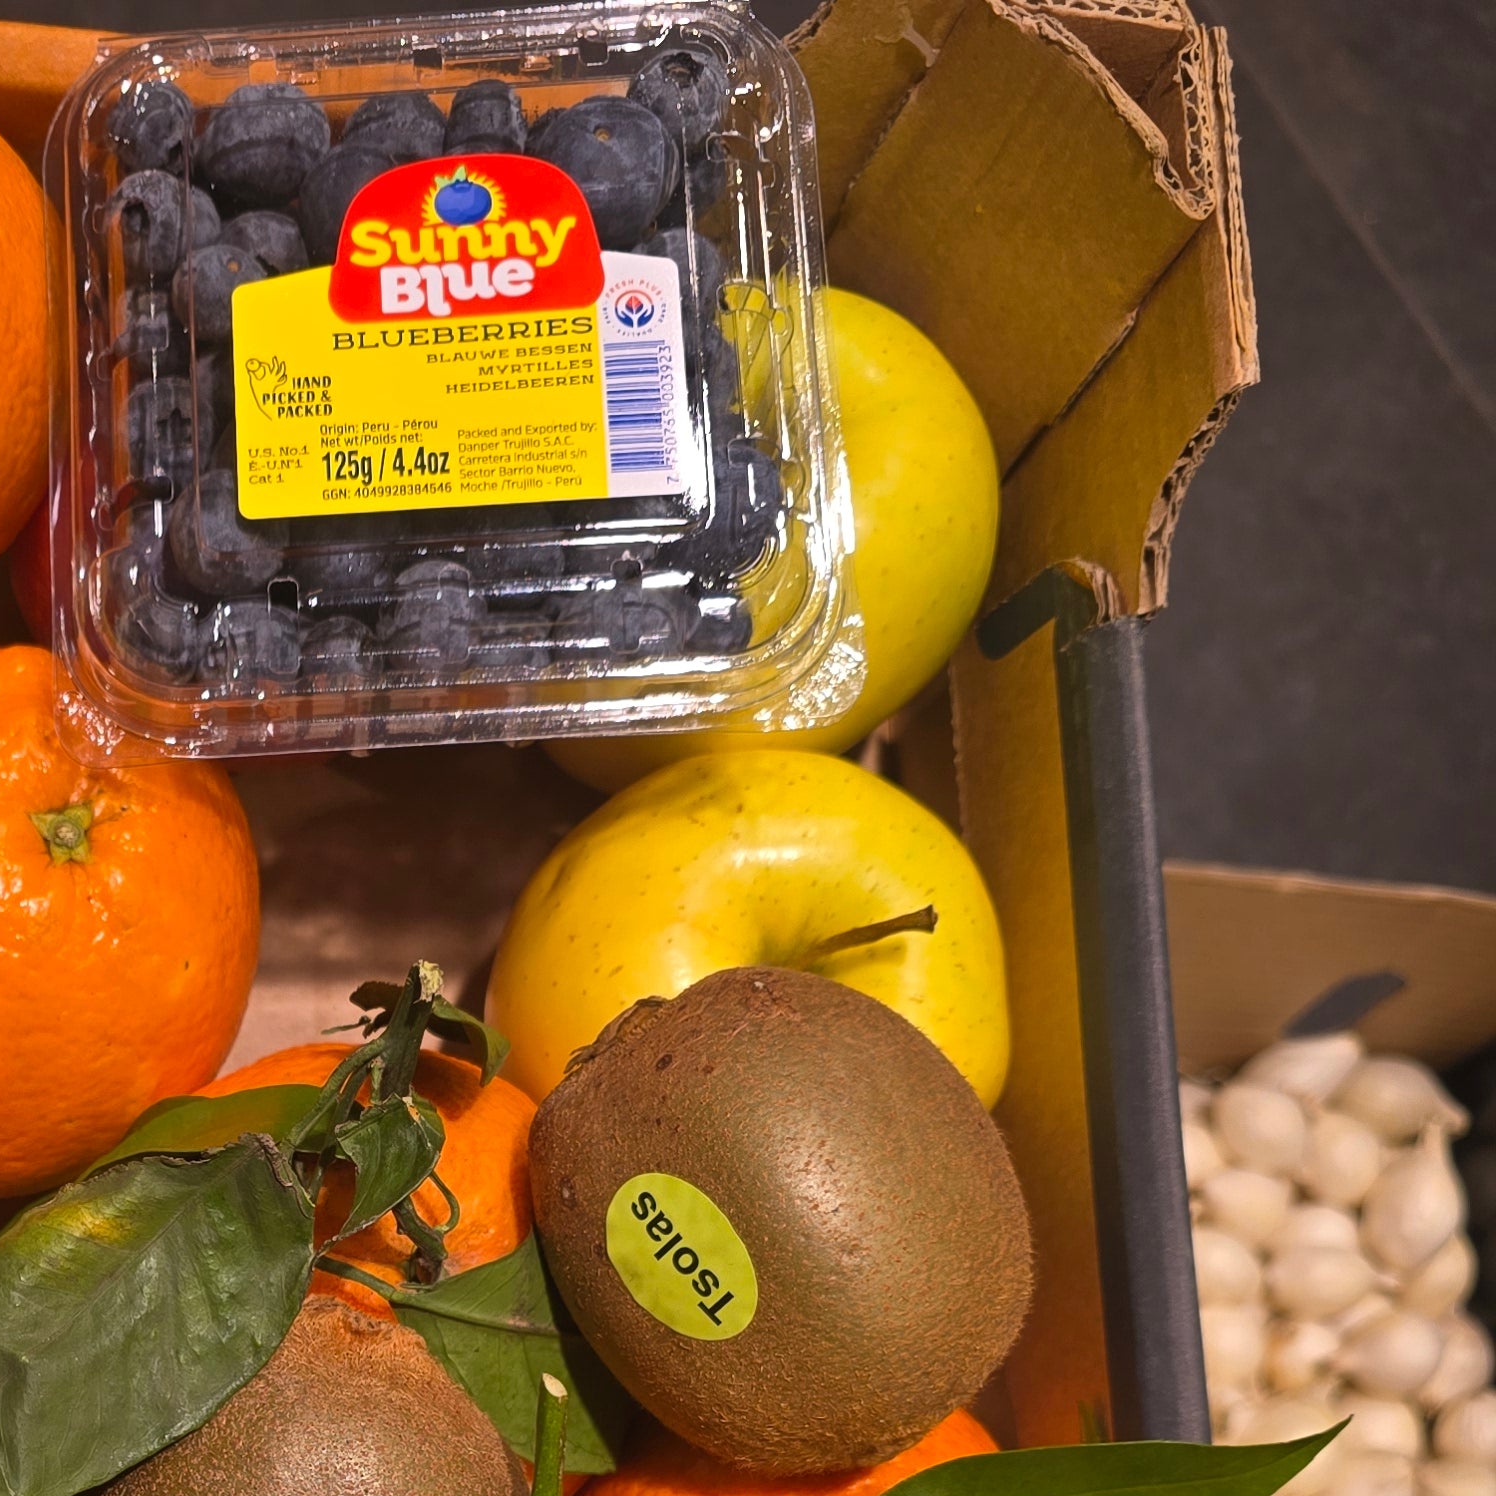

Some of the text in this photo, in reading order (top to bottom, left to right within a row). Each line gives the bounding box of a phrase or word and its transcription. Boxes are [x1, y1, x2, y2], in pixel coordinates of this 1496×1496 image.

[350, 216, 577, 268] Sunny
[380, 258, 535, 317] Blue
[332, 316, 594, 350] BLUEBERRIES
[426, 342, 593, 364] BLAUWE BESSEN
[478, 358, 594, 377] MYRTILLES
[292, 375, 332, 390] HAND
[445, 374, 595, 395] HEIDELBEEREN
[262, 389, 332, 406] PICKED &
[277, 403, 333, 419] PACKED
[319, 423, 359, 437] Origin:
[362, 421, 390, 433] Peru
[402, 419, 439, 431] Pérou
[457, 427, 498, 440] Packed
[500, 425, 522, 437] and
[525, 421, 578, 437] Exported
[320, 431, 423, 449] Net wt/Poids net:
[458, 440, 500, 454] Danper
[502, 438, 541, 451] Trujillo
[322, 446, 451, 487] 125g / 4.4oz
[458, 448, 588, 467] Carretera Industrial s/n
[248, 473, 273, 485] Cat
[459, 467, 496, 480] Sector
[499, 464, 534, 478] Barrio
[322, 487, 352, 501] GGN:
[460, 480, 498, 494] Moche
[630, 1191, 735, 1327] Tsolas
